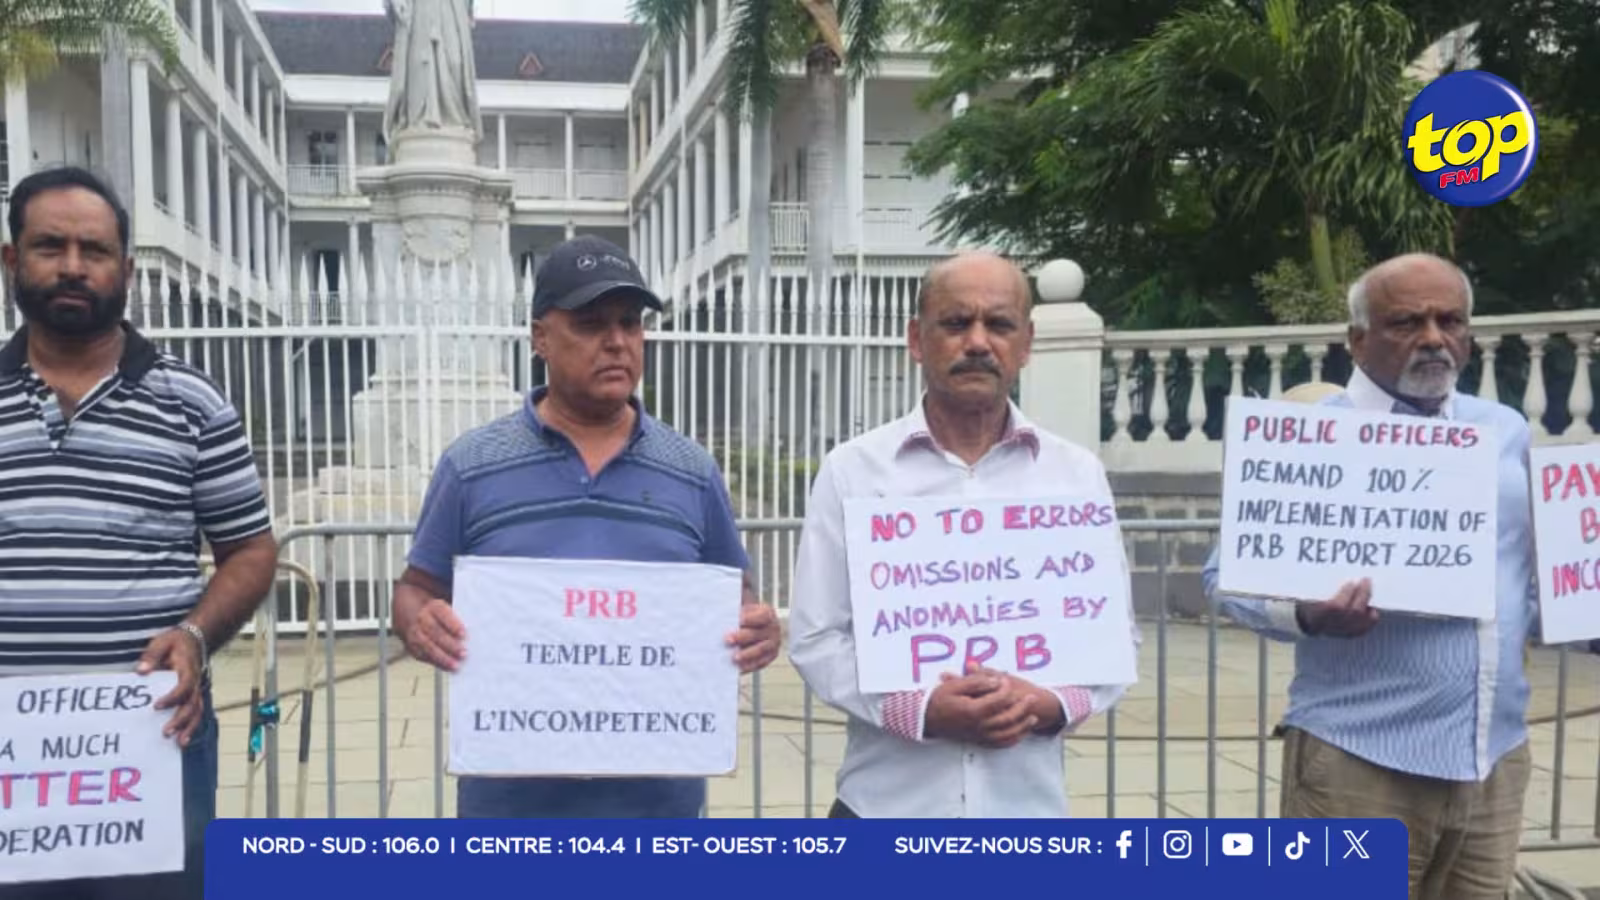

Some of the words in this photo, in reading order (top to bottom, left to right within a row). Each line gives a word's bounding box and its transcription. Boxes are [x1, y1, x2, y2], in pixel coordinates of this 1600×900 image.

[1243, 415, 1337, 443] PUBLIC
[1359, 423, 1479, 448] OFFICERS
[1241, 458, 1343, 489] DEMAND
[870, 511, 917, 542] NO
[936, 508, 984, 534] TO
[1003, 502, 1114, 530] ERRORS
[1237, 500, 1448, 532] IMPLEMENTATION
[1459, 510, 1487, 532] OF
[1236, 533, 1284, 559] PRB
[1297, 536, 1397, 566] REPORT
[1405, 544, 1472, 567] 2026
[870, 556, 1021, 590] OMISSIONS
[1035, 551, 1095, 580] AND
[564, 587, 637, 619] PRB
[1062, 596, 1107, 619] BY
[521, 642, 632, 667] TEMPLE
[640, 645, 676, 667] DE
[910, 633, 1052, 683] PRB
[17, 685, 152, 714] OFFICERS
[473, 709, 716, 733] L’INCOMPETENCE
[42, 733, 120, 762] MUCH
